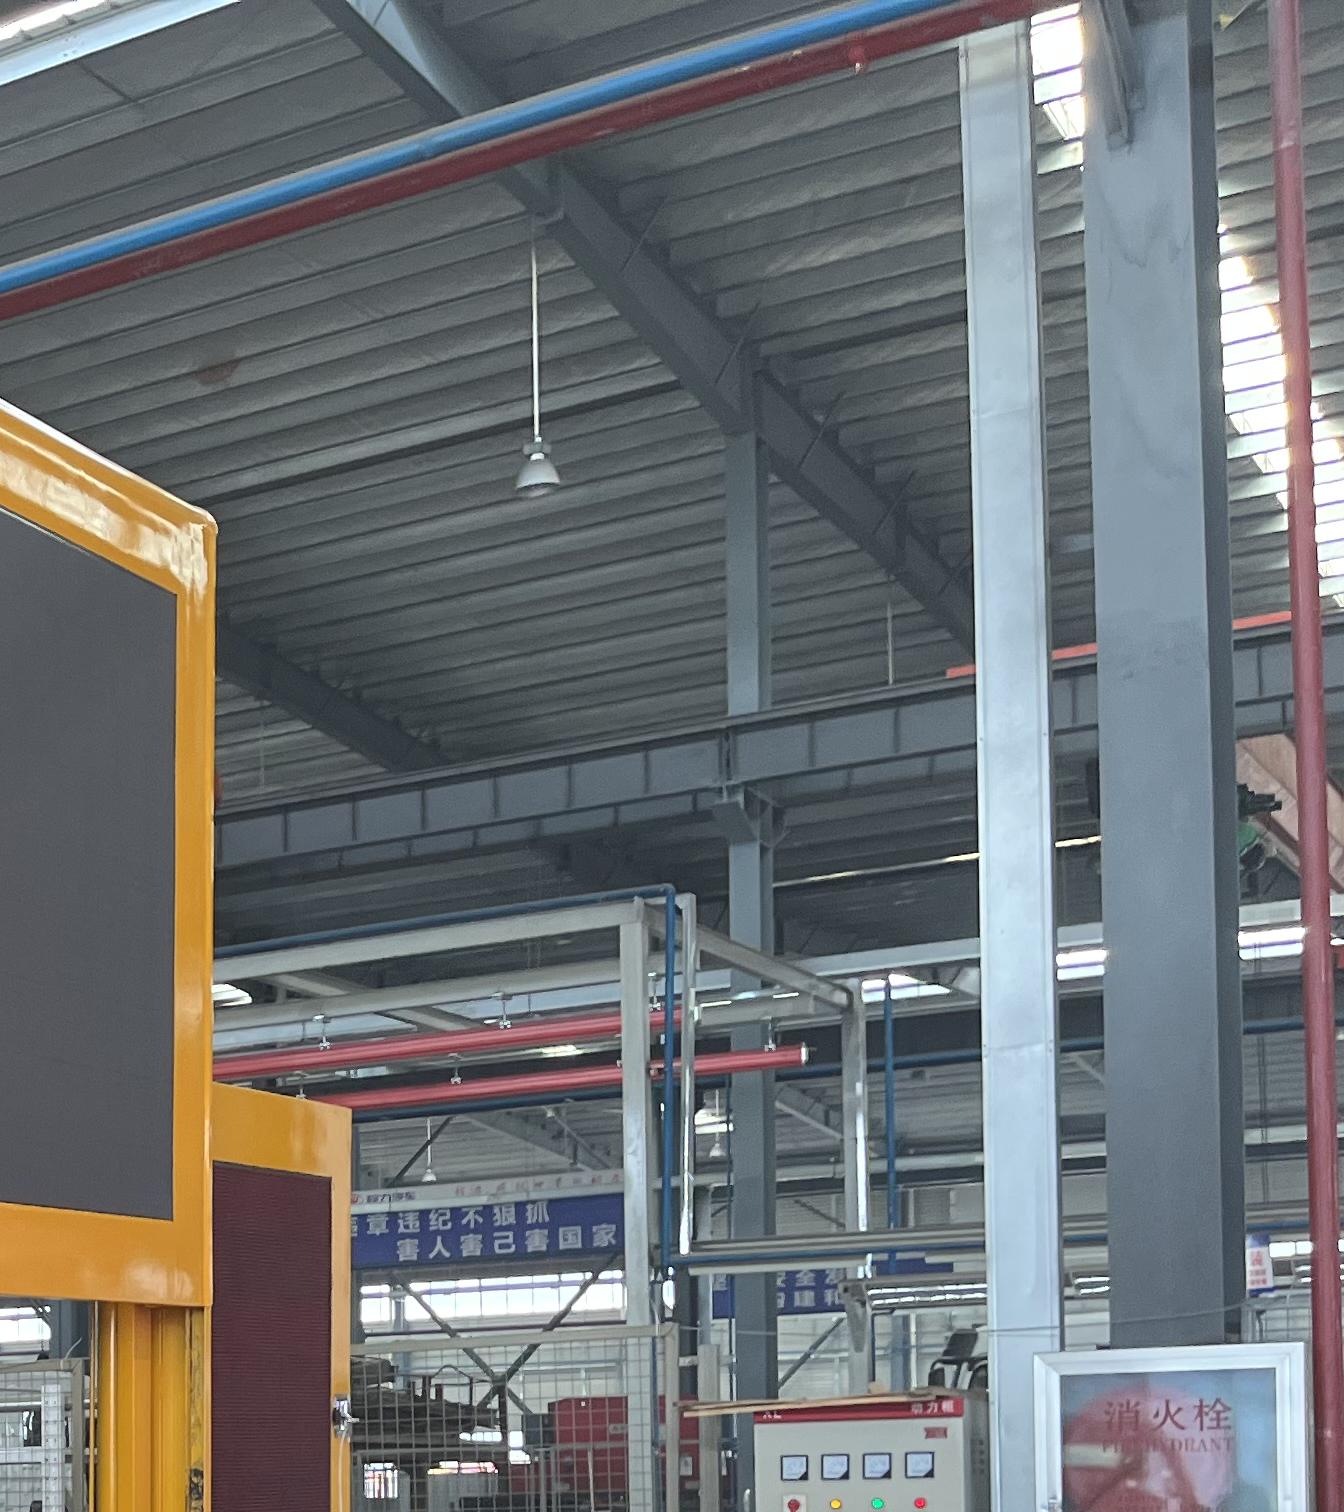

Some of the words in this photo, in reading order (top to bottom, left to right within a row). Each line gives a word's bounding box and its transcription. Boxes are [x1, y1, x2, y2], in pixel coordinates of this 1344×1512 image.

[397, 1223, 617, 1262] 害人害己害国家
[1104, 1398, 1232, 1432] 消火栓
